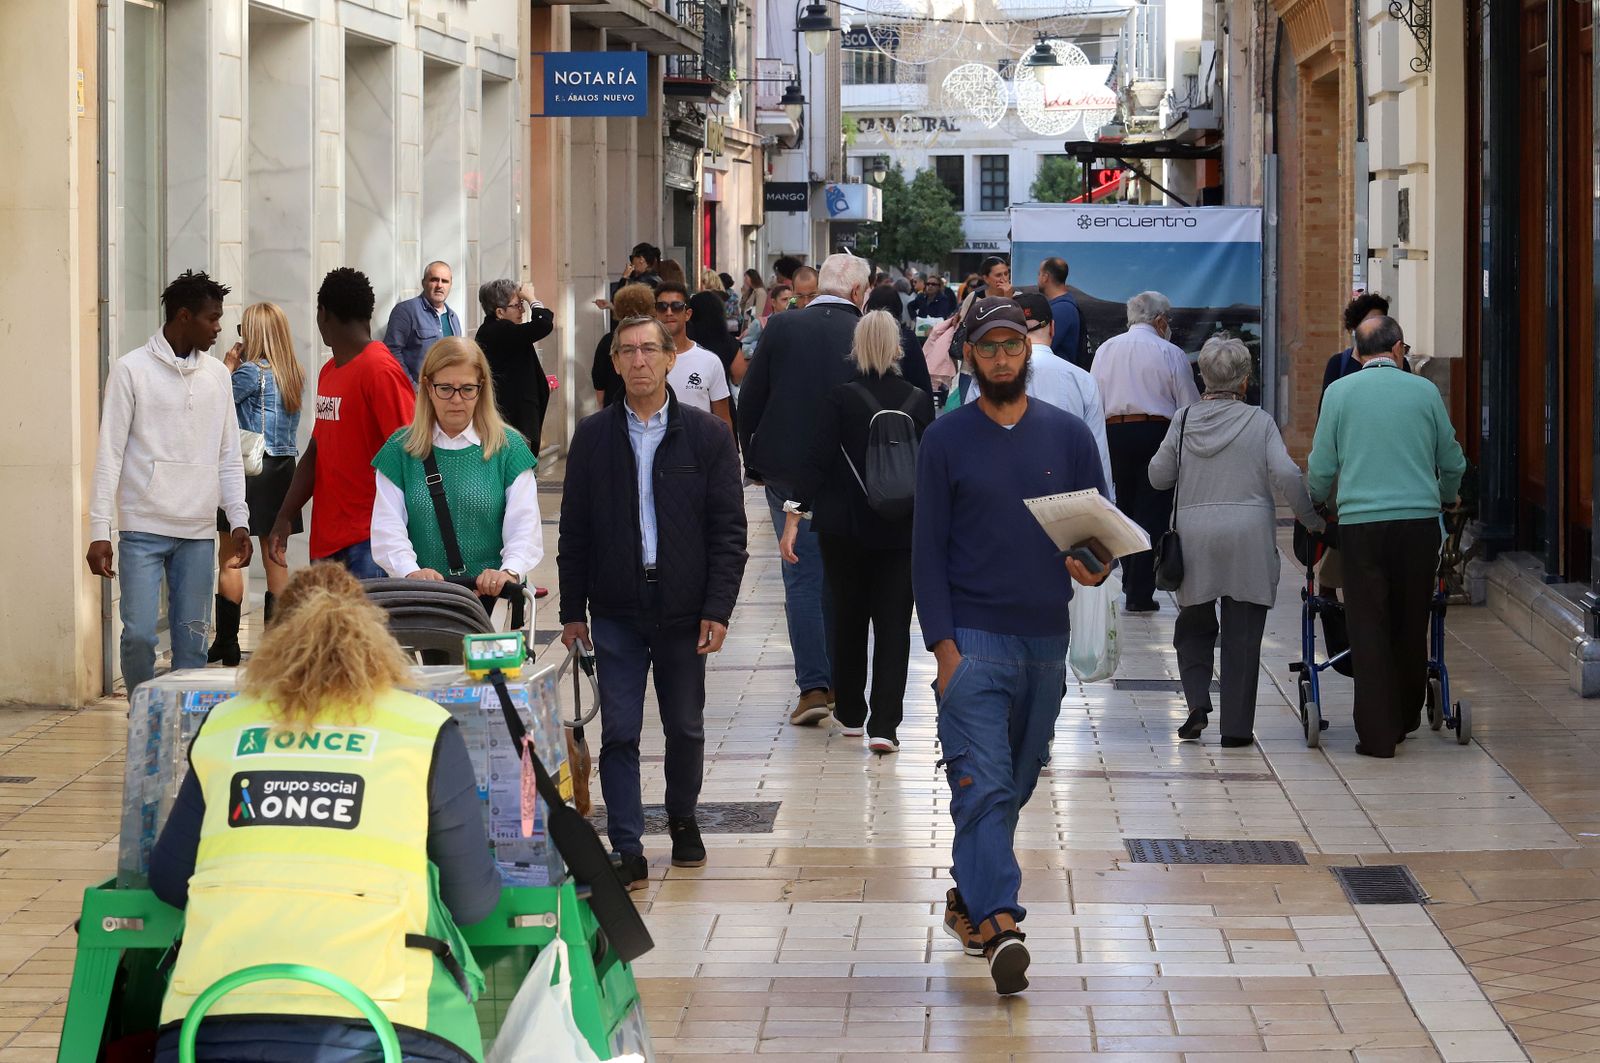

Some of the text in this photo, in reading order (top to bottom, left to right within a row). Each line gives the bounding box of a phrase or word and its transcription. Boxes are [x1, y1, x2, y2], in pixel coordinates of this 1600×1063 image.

[555, 67, 637, 85] NOTARÍA
[568, 93, 599, 102] ÁBALOS
[603, 94, 635, 102] NUEVO
[766, 192, 806, 201] MANGO
[1094, 215, 1197, 228] encuentro
[274, 731, 366, 752] ONCE
[263, 780, 357, 795] grupo social
[260, 796, 354, 823] ONCE
